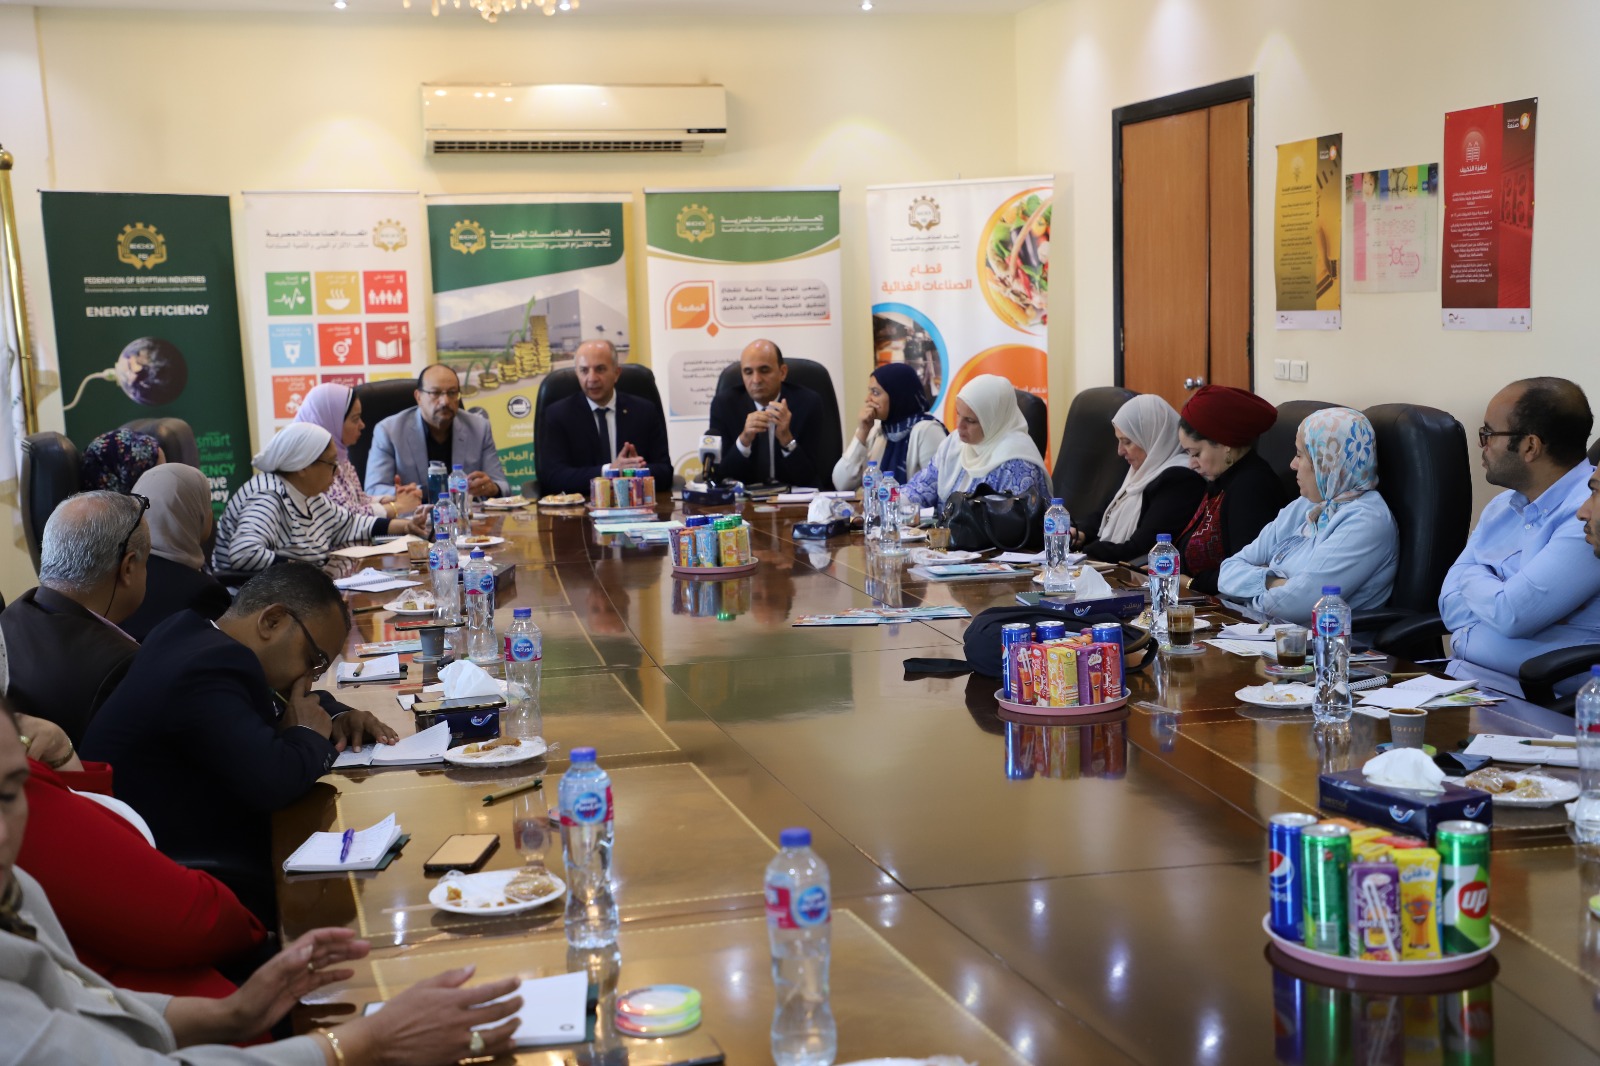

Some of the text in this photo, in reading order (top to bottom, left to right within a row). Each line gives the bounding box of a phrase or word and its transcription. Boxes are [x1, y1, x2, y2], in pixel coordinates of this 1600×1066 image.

[910, 263, 942, 277] قطاع
[84, 275, 206, 285] FEDERATION OF EGYPTIAN INDUSTRIES
[881, 279, 972, 295] الصناعات الغذائية
[86, 304, 209, 318] ENERGY EFFICIENCY
[676, 303, 706, 313] المهمة
[196, 433, 231, 449] smart
[199, 463, 236, 477] ENCY
